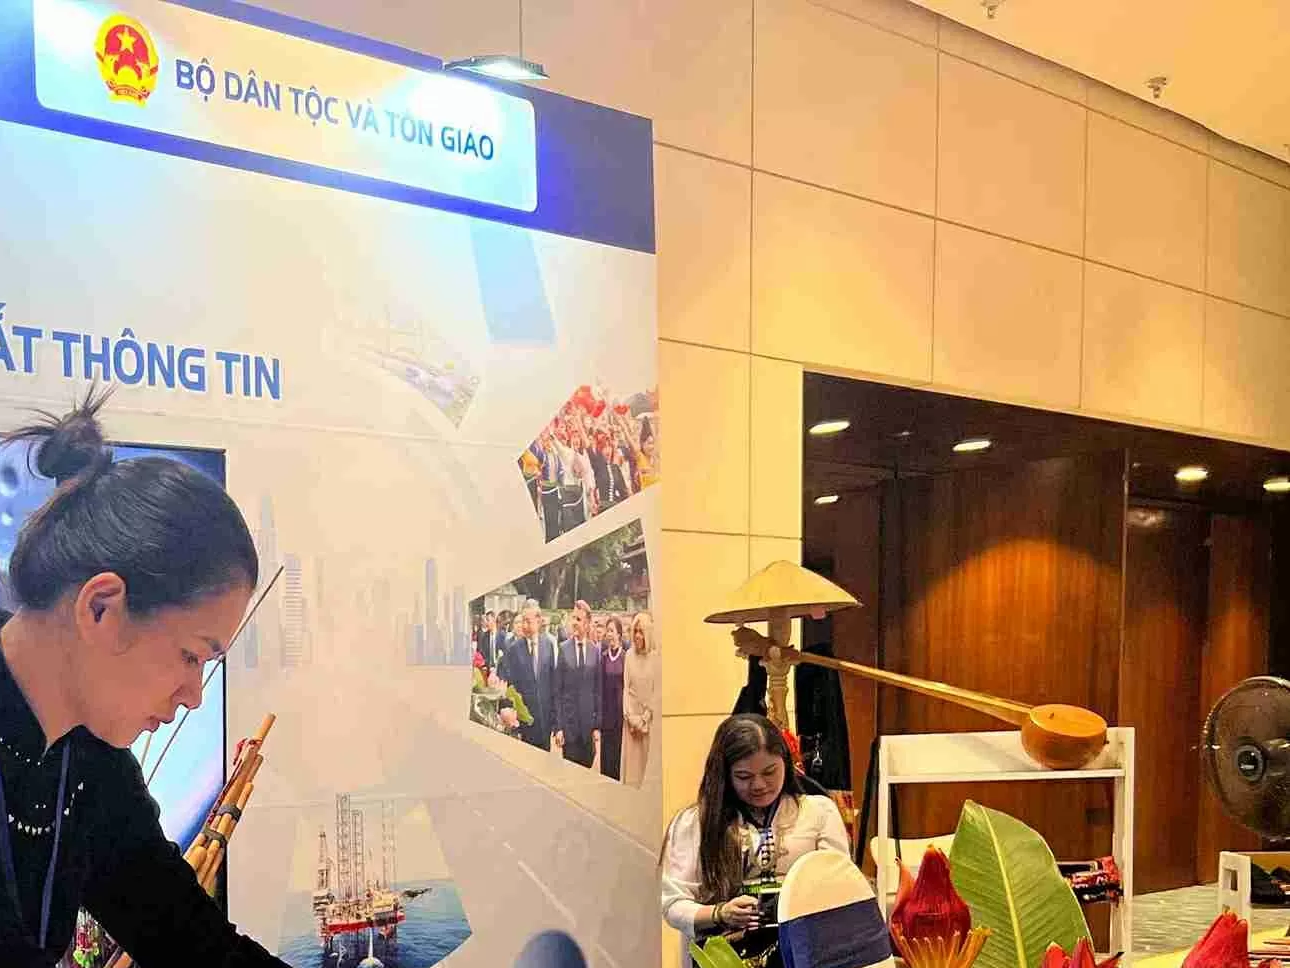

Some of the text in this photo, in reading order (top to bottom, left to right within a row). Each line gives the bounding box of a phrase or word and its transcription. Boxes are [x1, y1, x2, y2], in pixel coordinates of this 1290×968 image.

[175, 57, 494, 161] BỘ DÂN TỘC VÀ TÔN GIÁO
[52, 328, 207, 393] THÔNG
[215, 351, 282, 400] TIN
